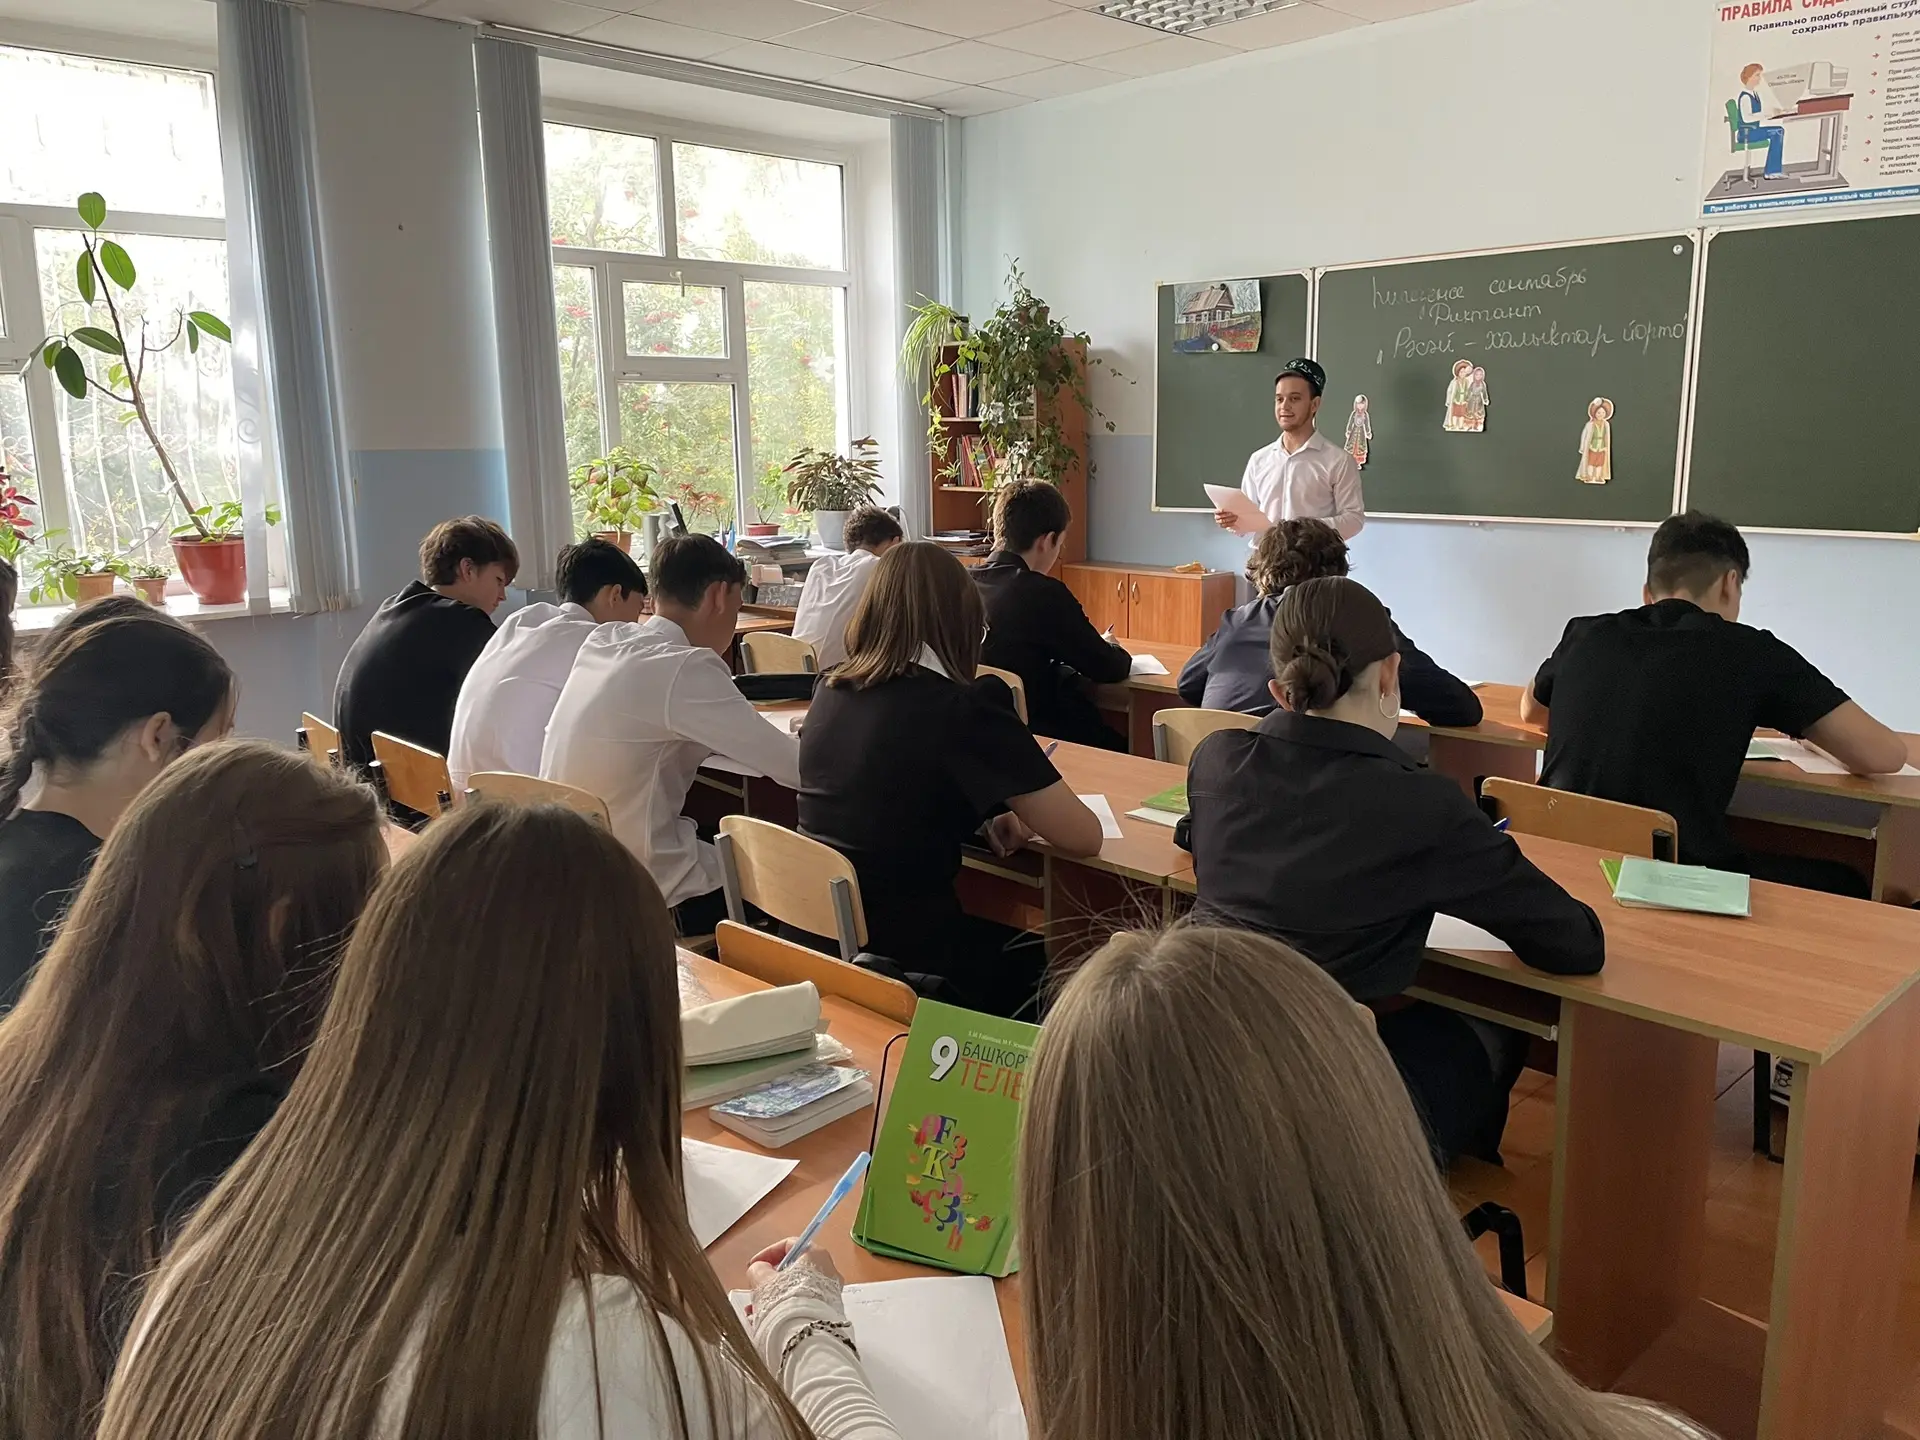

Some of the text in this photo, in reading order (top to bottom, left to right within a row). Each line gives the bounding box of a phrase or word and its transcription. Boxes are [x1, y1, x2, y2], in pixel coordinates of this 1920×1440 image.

[1721, 0, 1792, 21] ПРАВИЛА
[1749, 0, 1917, 32] Правильно подобранный стул
[1792, 21, 1849, 35] сохранить
[1829, 192, 1858, 202] каждый
[1873, 188, 1919, 198] необходимо
[1428, 302, 1542, 326] Диктант
[929, 1035, 960, 1082] 9
[962, 1041, 1029, 1069] БАШҠОР
